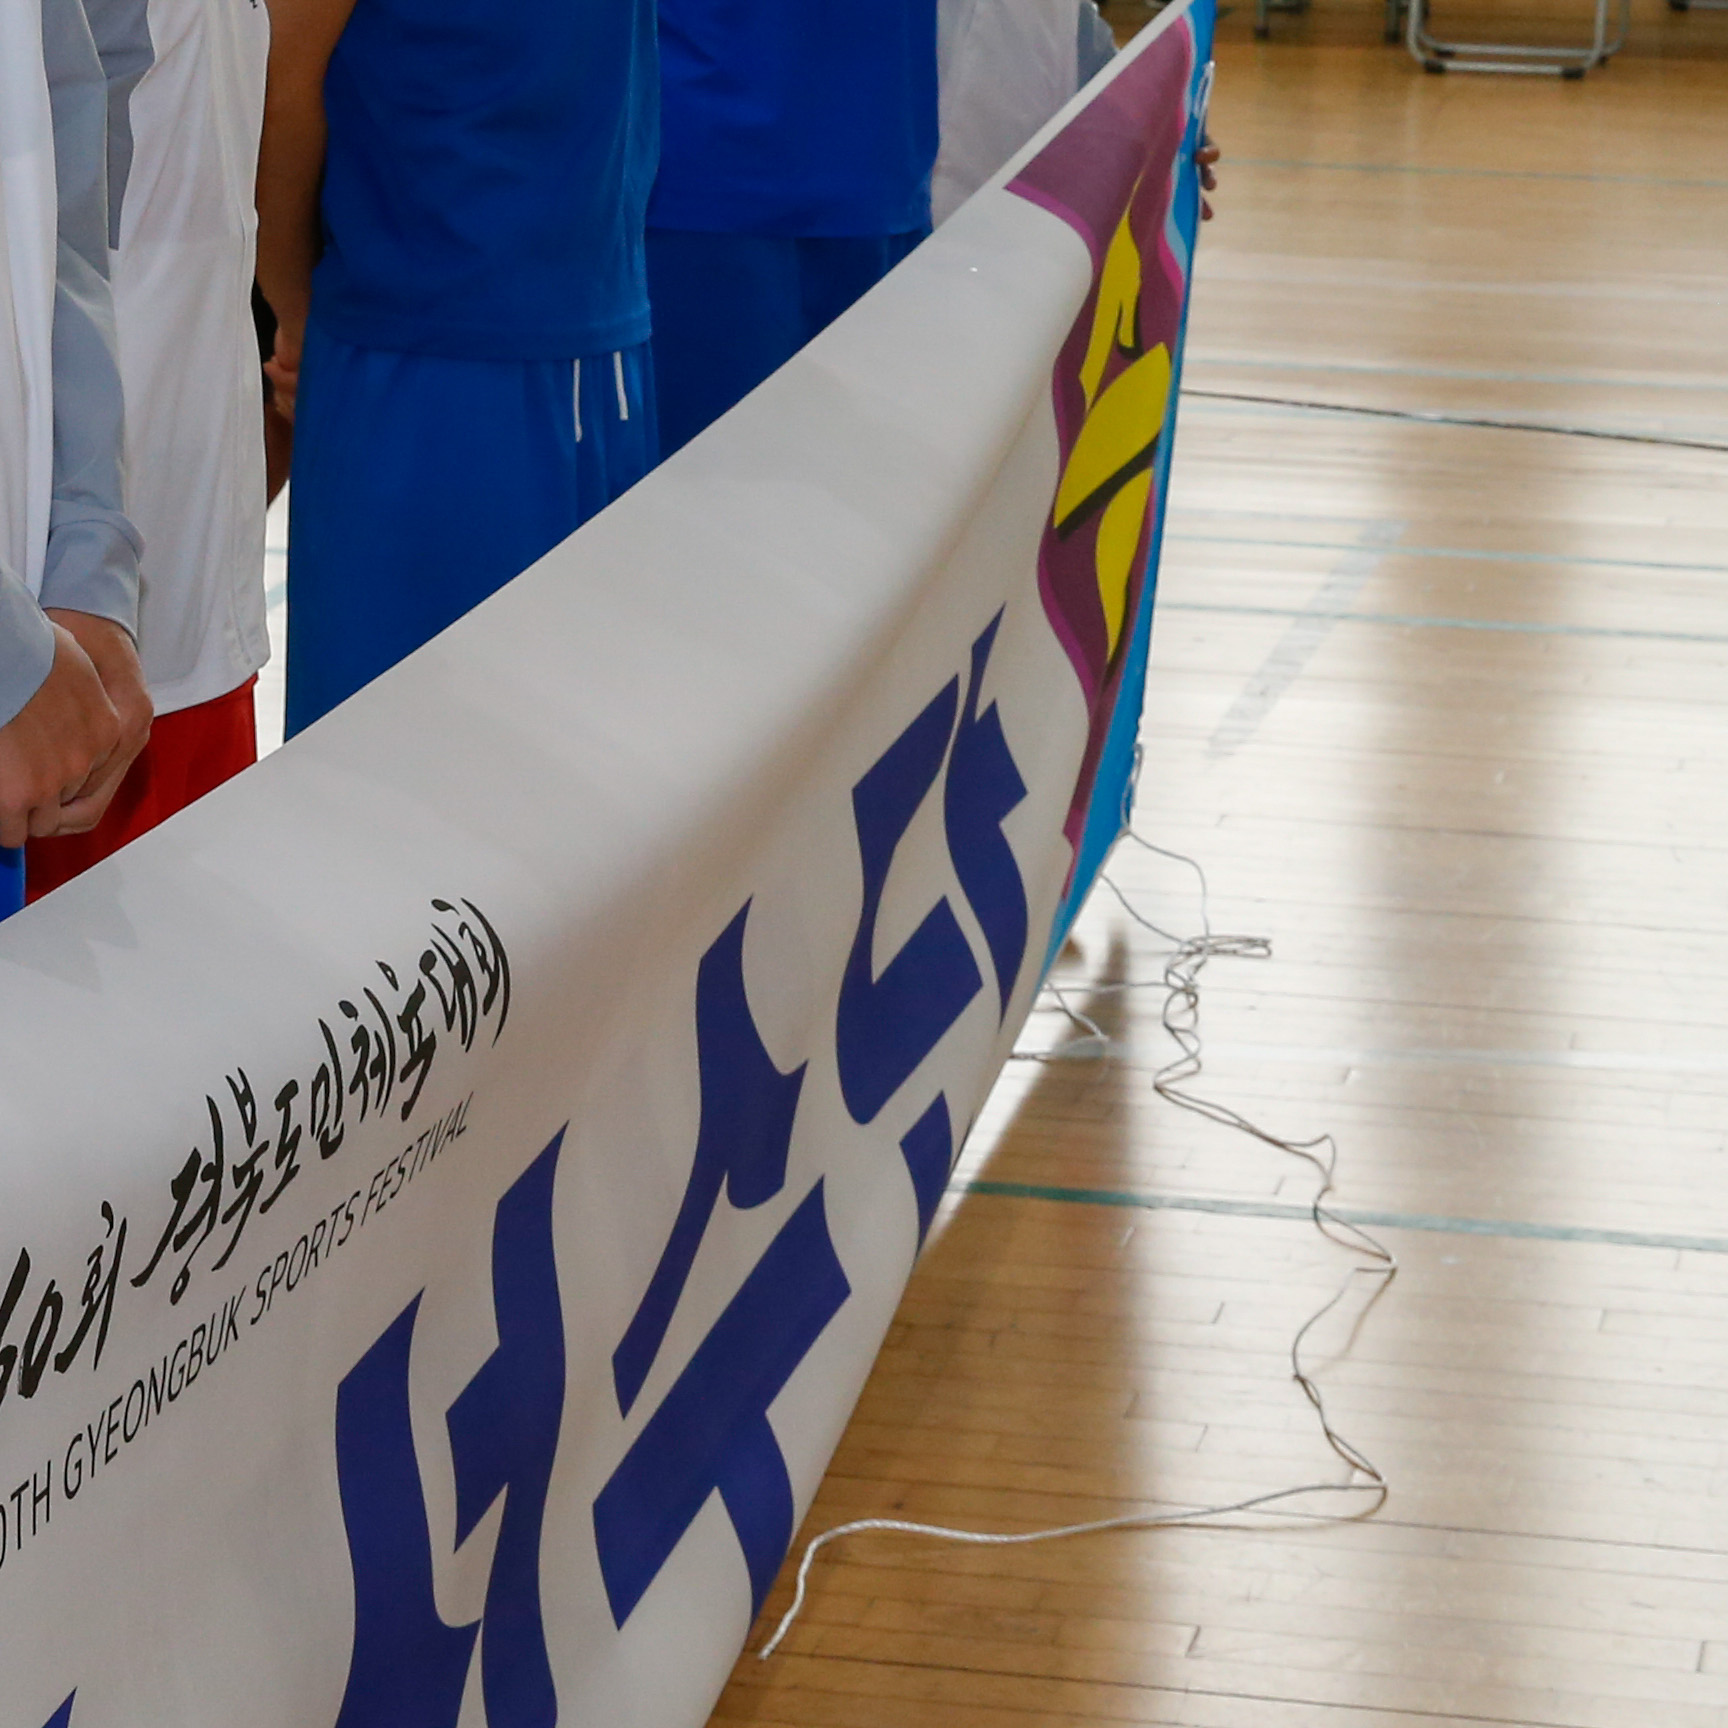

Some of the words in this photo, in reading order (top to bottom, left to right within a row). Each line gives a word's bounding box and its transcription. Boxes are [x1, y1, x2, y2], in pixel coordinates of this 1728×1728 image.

[63, 1285, 247, 1500] GYEONGBUK
[249, 1190, 362, 1326] SPORTS
[360, 1091, 474, 1227] FESTIVAL
